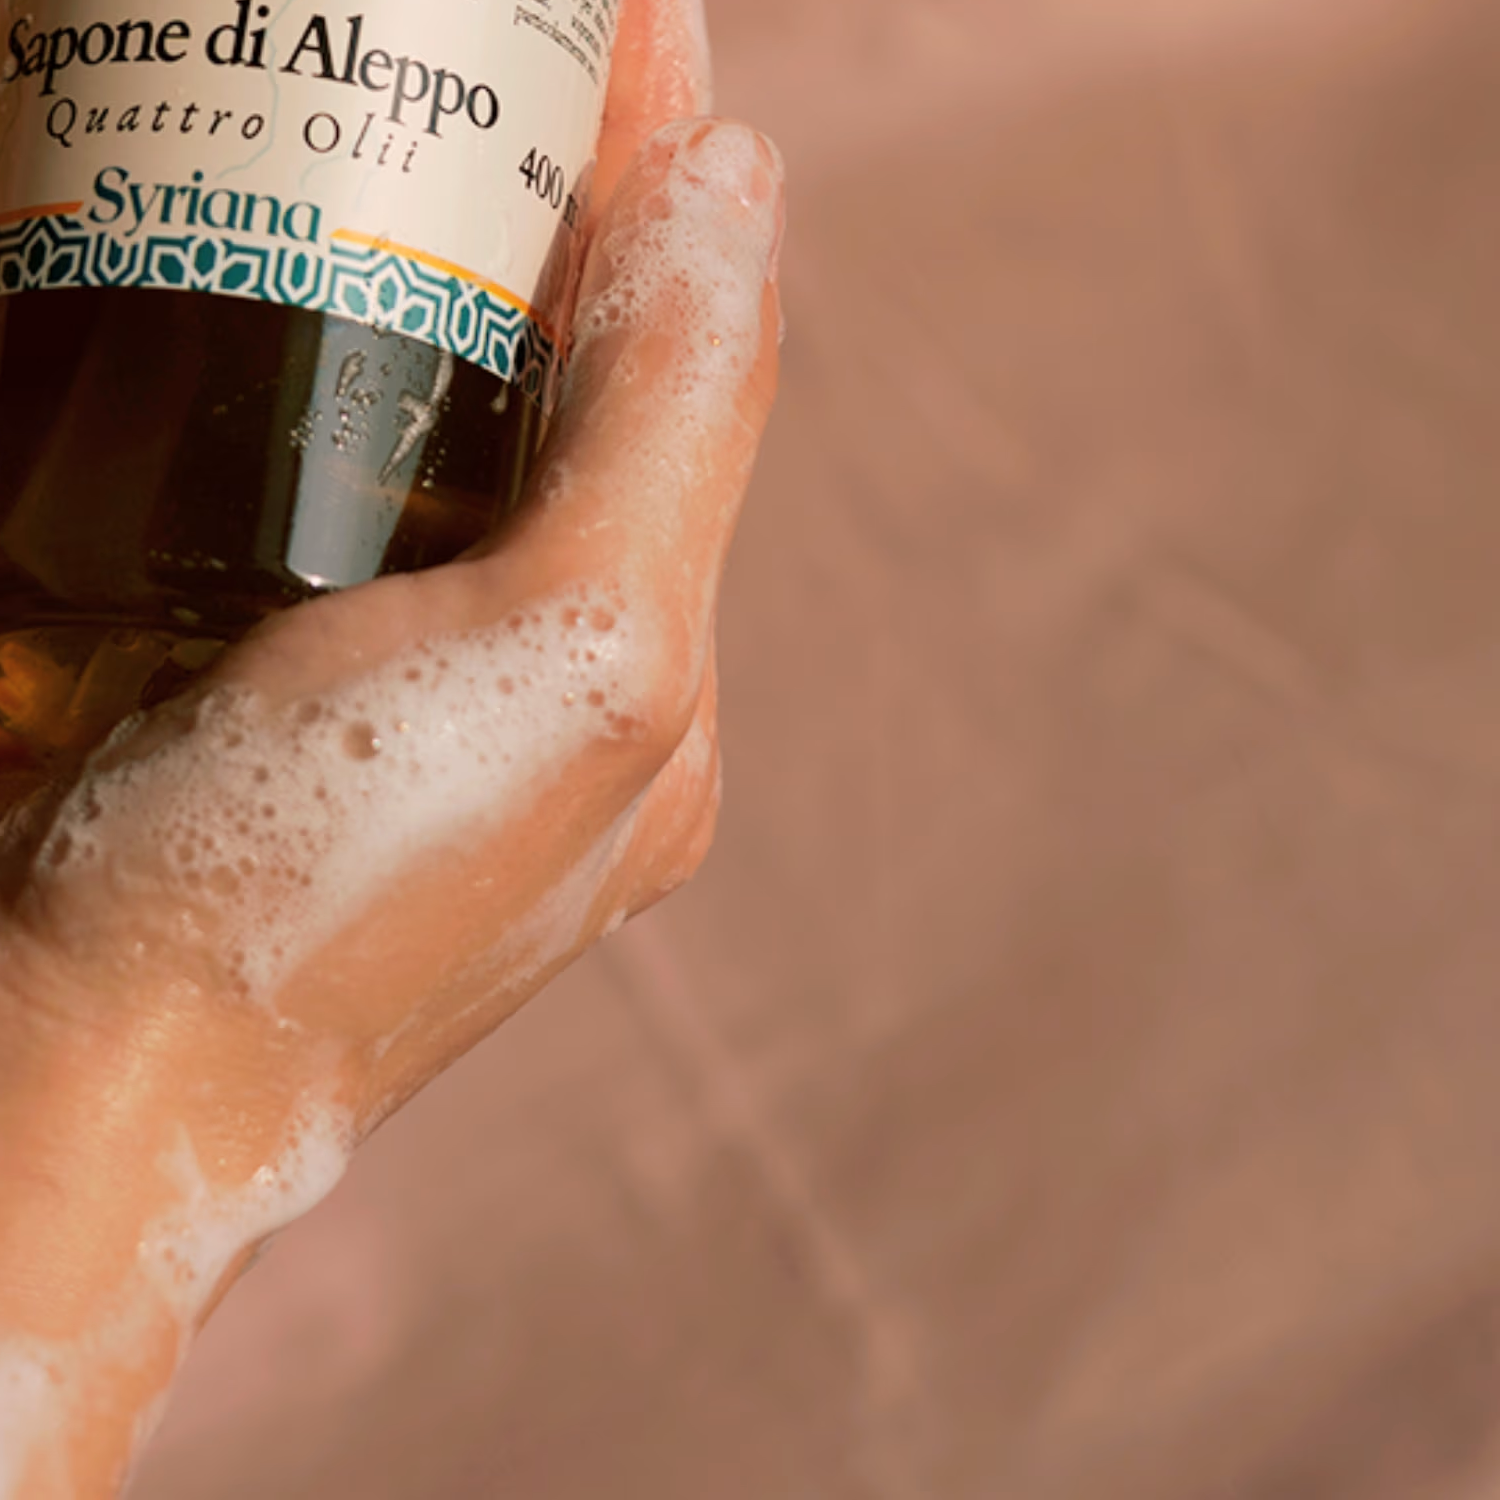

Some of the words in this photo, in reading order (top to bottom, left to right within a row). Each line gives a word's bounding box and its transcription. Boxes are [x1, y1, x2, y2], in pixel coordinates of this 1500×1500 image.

[3, 18, 190, 97] Sapone
[280, 14, 499, 138] Aleppo
[46, 97, 264, 148] Quattro
[303, 111, 418, 173] Olii
[87, 166, 321, 244] Syriana
[518, 146, 565, 210] 400
